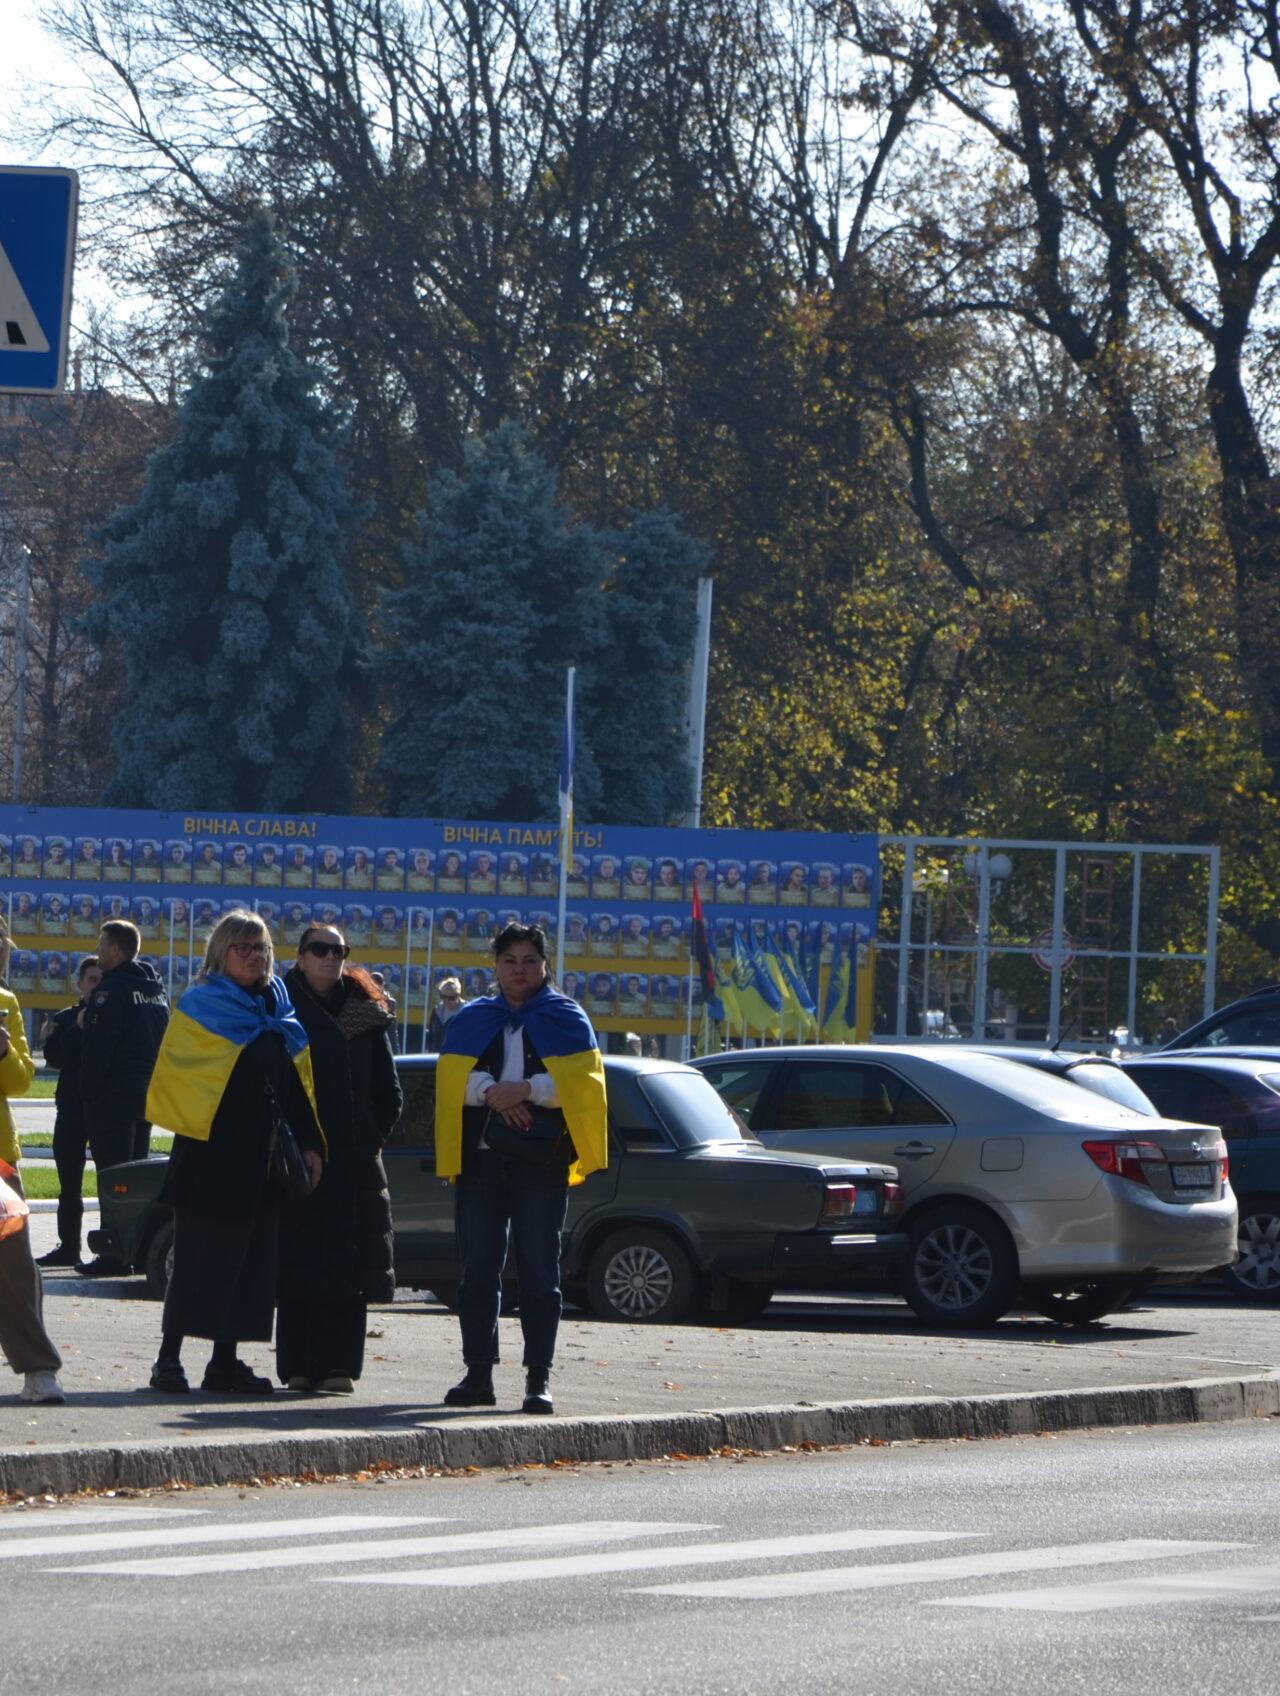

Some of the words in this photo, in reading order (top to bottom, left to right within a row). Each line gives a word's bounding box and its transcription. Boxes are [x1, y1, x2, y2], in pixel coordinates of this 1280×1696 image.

[184, 817, 240, 835] ВІЧНА
[245, 819, 317, 838] СЛАВА!
[443, 826, 503, 845] ВІЧНА
[508, 828, 603, 848] ПАМ'ТЬ!
